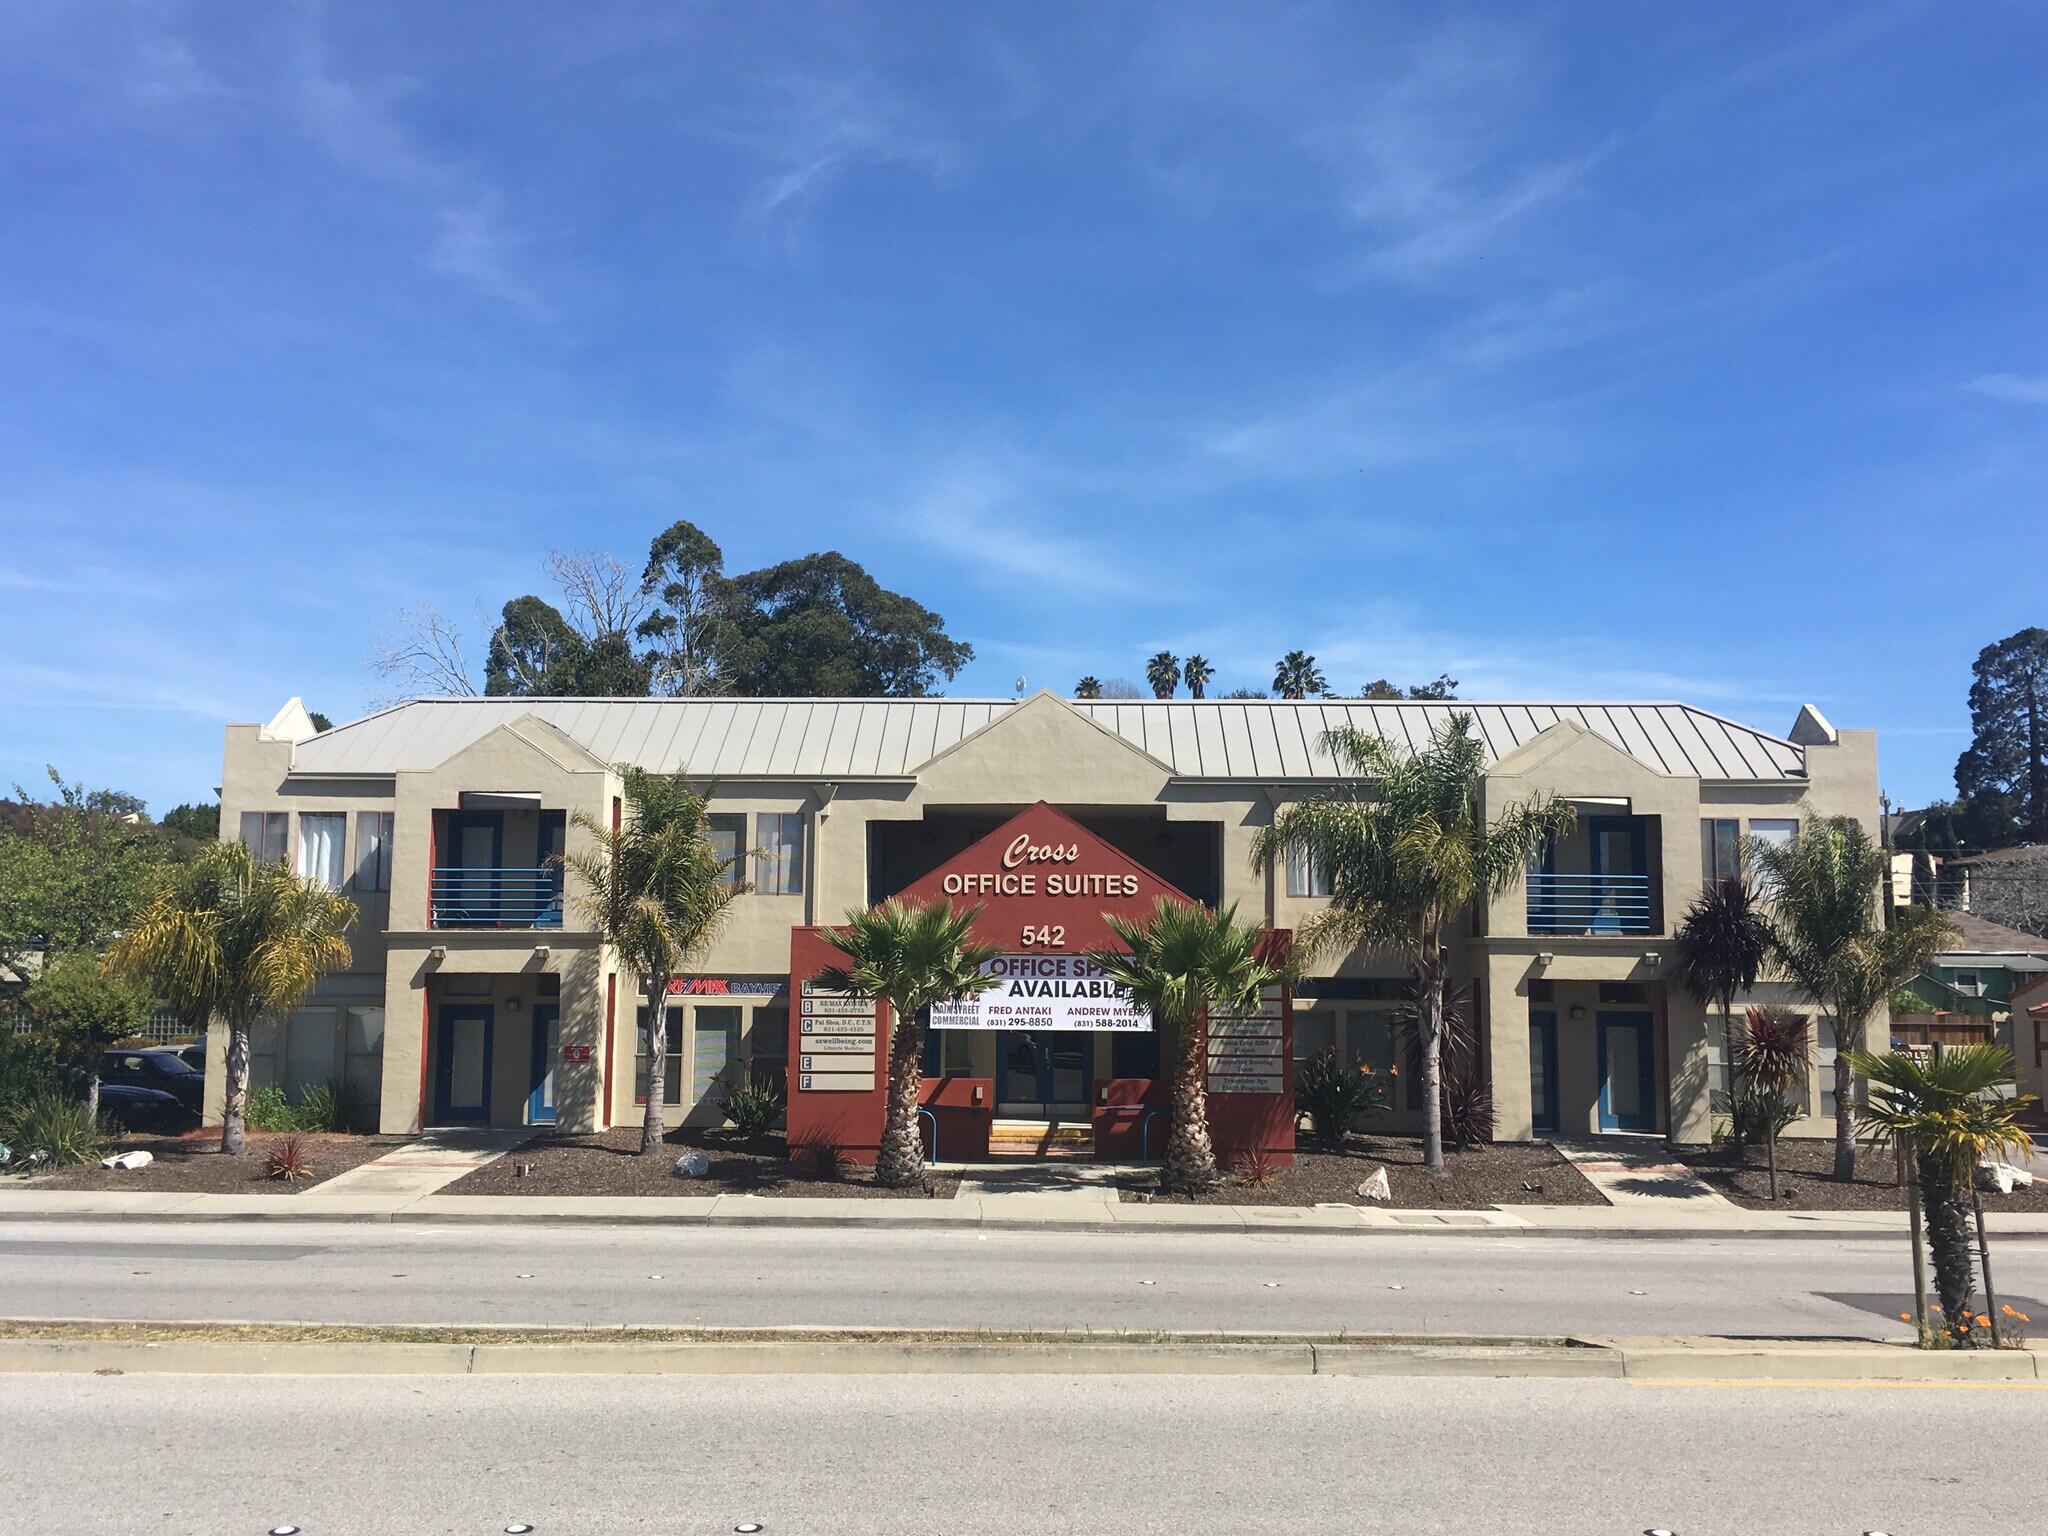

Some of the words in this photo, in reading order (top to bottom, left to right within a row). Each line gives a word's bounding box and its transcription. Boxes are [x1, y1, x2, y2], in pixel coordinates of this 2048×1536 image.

[1003, 833, 1080, 867] Cross
[943, 873, 1037, 895] OFFICE
[1046, 873, 1139, 895] SUITES
[1021, 926, 1066, 946] 542
[990, 958, 1066, 977] OFFICE
[667, 977, 731, 994] RE/MAX
[804, 982, 812, 994] A
[1008, 980, 1124, 998] AVAILABLE
[804, 1002, 812, 1012] B
[988, 1006, 1013, 1016] FRED
[1015, 1006, 1052, 1016] ANTAKI
[1067, 1007, 1111, 1017] ANDREW
[804, 1020, 812, 1031] C
[932, 1015, 980, 1026] COMMERCIAL
[986, 1018, 1007, 1028] (831)
[1008, 1017, 1053, 1027] 295-8850
[1074, 1019, 1094, 1028] (831)
[1095, 1018, 1138, 1028] 588-2014
[815, 1037, 873, 1045] scwellbeing.com
[803, 1057, 811, 1069] E
[803, 1076, 811, 1088] F
